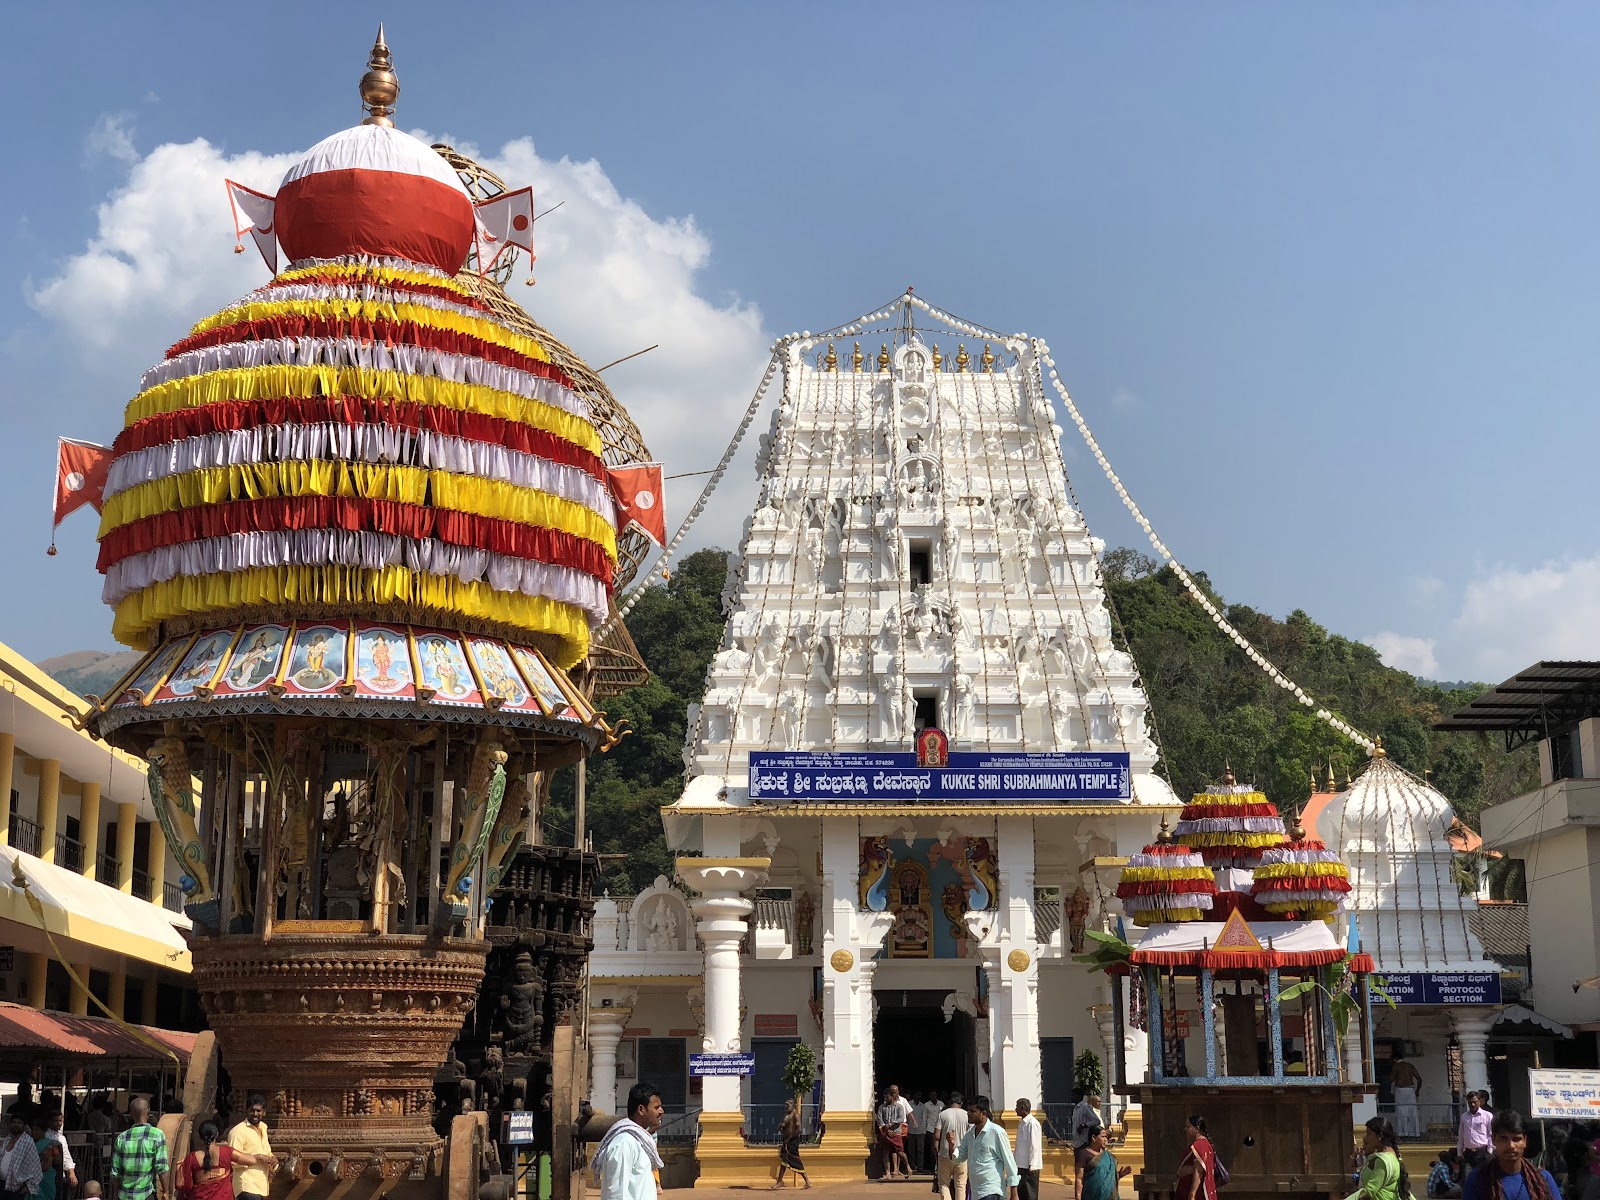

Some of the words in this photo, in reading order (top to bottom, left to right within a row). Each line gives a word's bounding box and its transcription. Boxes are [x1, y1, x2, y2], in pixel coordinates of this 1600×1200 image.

[760, 771, 789, 795] ಕುಕ್ಕೆ
[793, 772, 811, 793] ಶ್ರೀ
[815, 771, 869, 795] ಸುಬ್ರಹ್ಮಣ್ಯ
[873, 771, 931, 795] ದೇವಸ್ಥಾನ
[941, 774, 975, 790] KUKKE
[977, 774, 1001, 790] SHRI
[1003, 774, 1077, 790] SUBRAHMANYA
[1079, 773, 1118, 790] TEMPLE
[1467, 974, 1492, 983] ವಿಭಾಗ
[1438, 986, 1486, 994] PROTOCOL
[1369, 995, 1402, 1003] CENER
[1443, 995, 1483, 1003] SECTION
[1566, 1108, 1596, 1116] CHAPPAL
